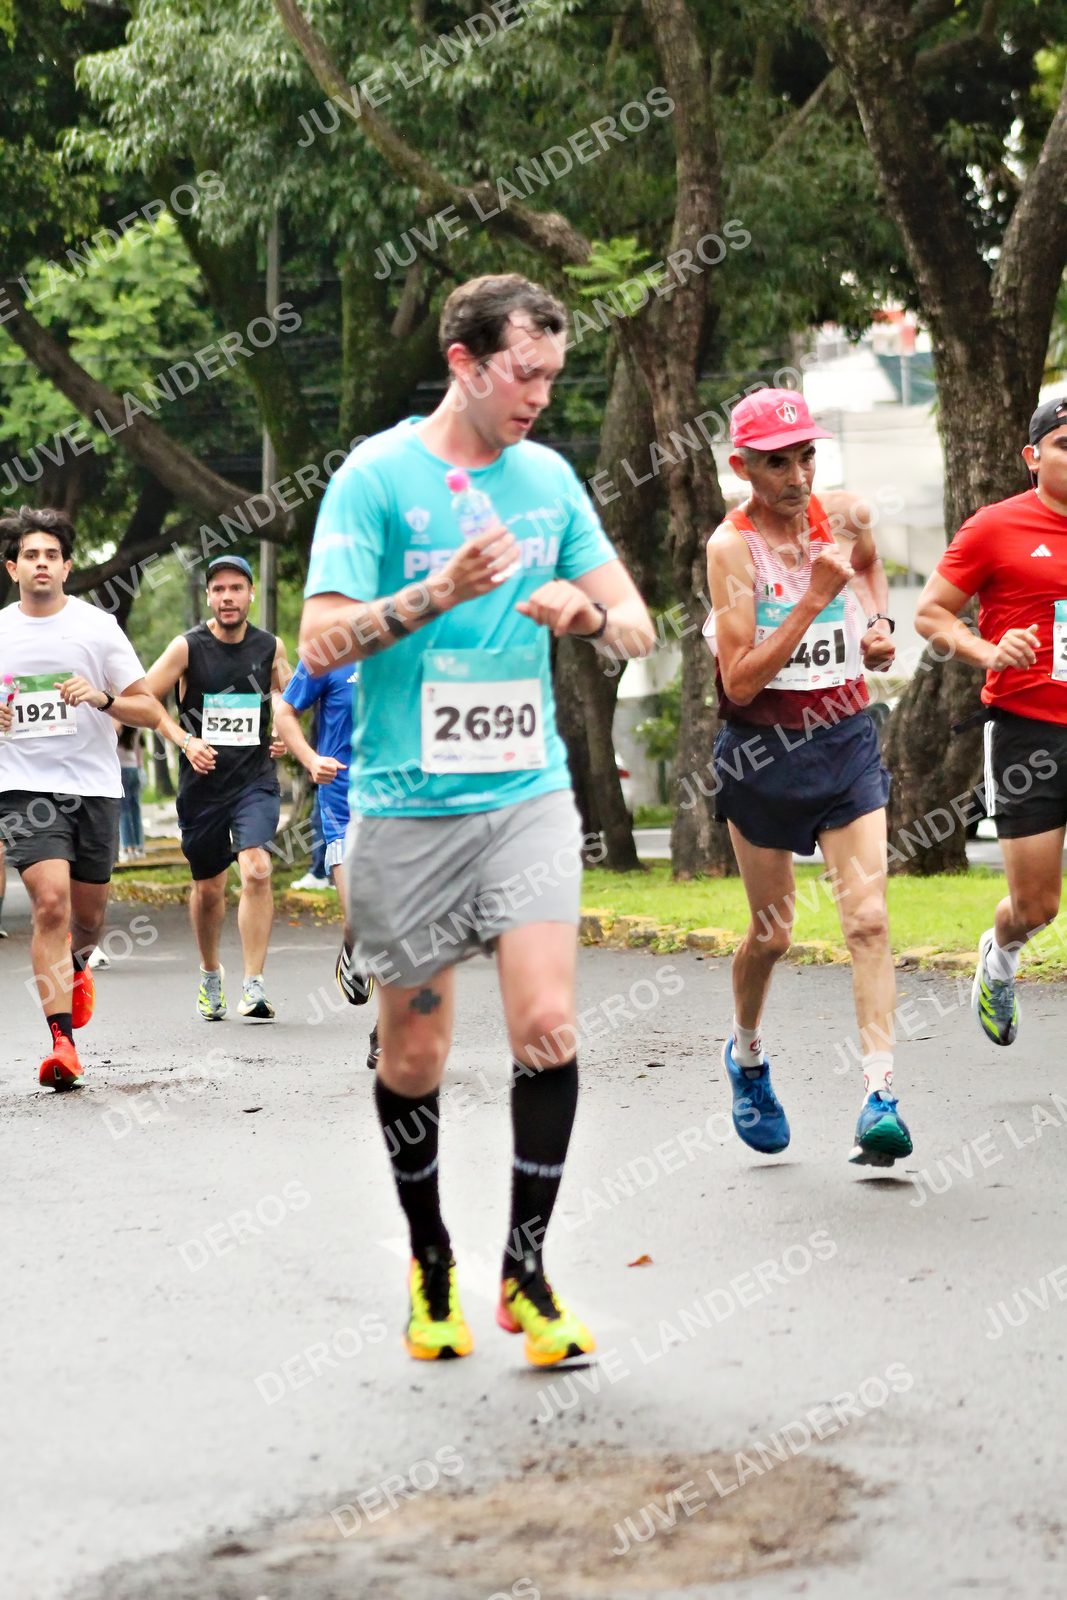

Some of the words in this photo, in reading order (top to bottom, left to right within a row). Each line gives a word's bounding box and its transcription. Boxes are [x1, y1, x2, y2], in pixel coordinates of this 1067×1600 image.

[15, 701, 67, 723] 1921
[434, 703, 536, 741] 2690
[207, 717, 253, 733] 5221
